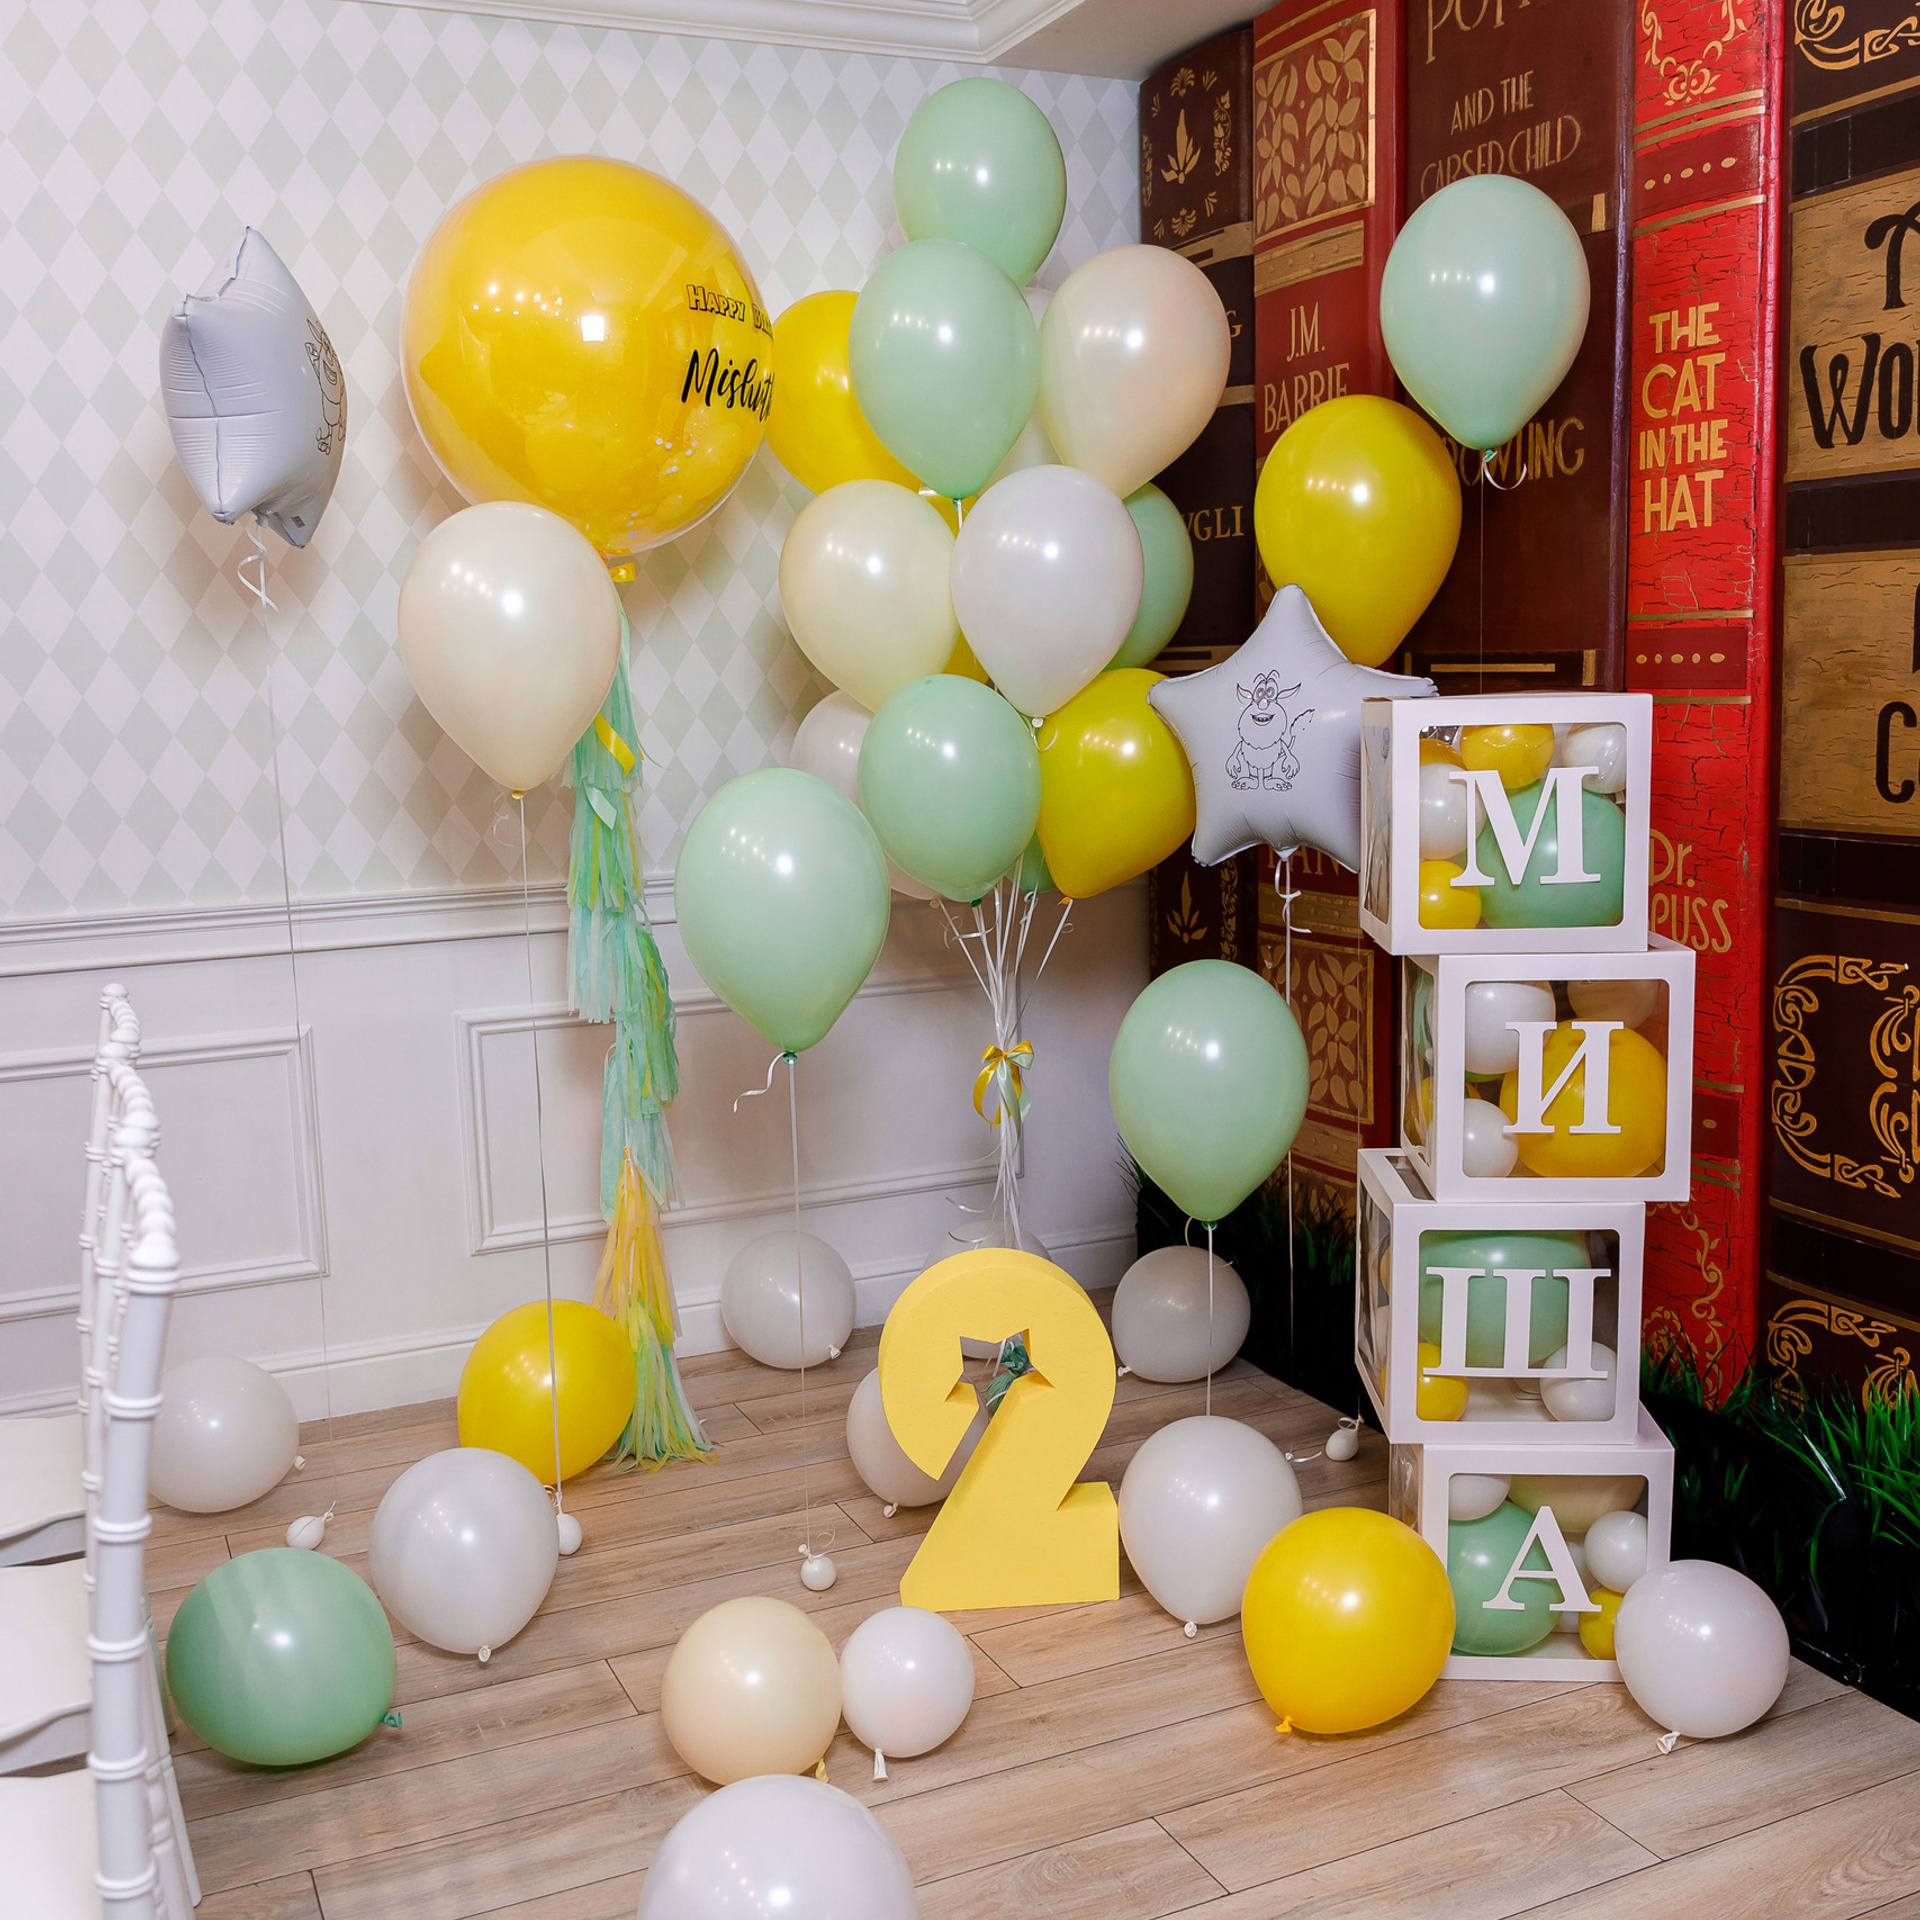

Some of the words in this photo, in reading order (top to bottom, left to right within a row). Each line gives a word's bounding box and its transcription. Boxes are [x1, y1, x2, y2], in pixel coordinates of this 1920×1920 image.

[1451, 87, 1495, 136] AND
[1500, 69, 1534, 115] THE
[1508, 114, 1582, 175] CHILD
[686, 283, 746, 322] HAPPY
[1285, 301, 1326, 363] J.M.
[1649, 302, 1720, 354] THE
[1263, 362, 1350, 433] BARRIE
[1641, 352, 1726, 419] CAT
[1799, 332, 1920, 449] WO
[1639, 427, 1666, 471] IN
[1670, 418, 1729, 465] THE
[1644, 469, 1725, 533] HAT
[1649, 828, 1695, 887] Dr.
[878, 1247, 1121, 1612] 2
